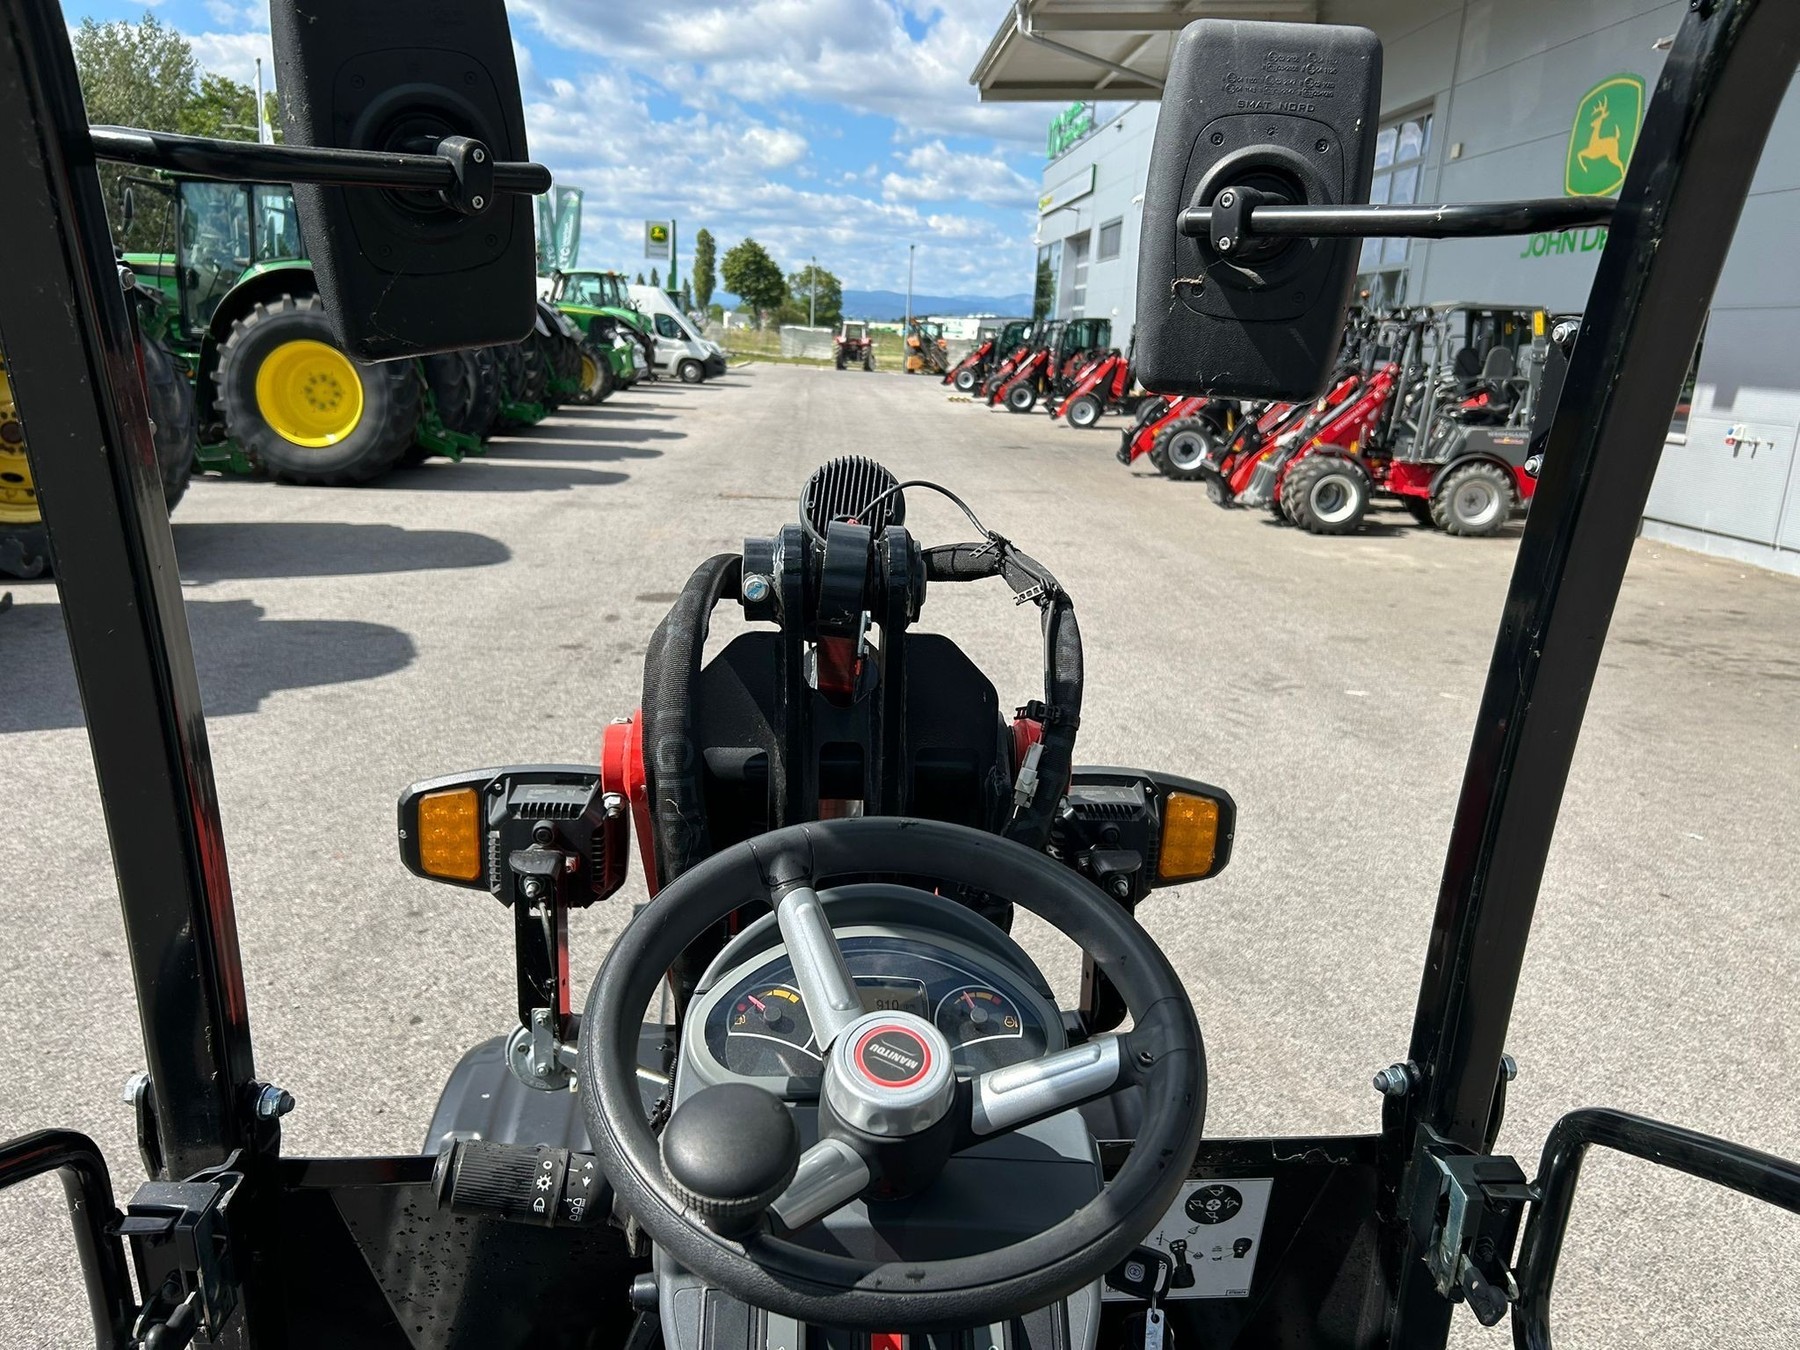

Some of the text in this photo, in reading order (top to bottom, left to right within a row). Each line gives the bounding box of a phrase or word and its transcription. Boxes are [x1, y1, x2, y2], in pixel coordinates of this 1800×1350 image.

[1237, 99, 1316, 113] SMAT NORD
[1520, 229, 1578, 259] JOHN
[876, 999, 900, 1011] 910
[868, 1043, 919, 1070] MANITOU
